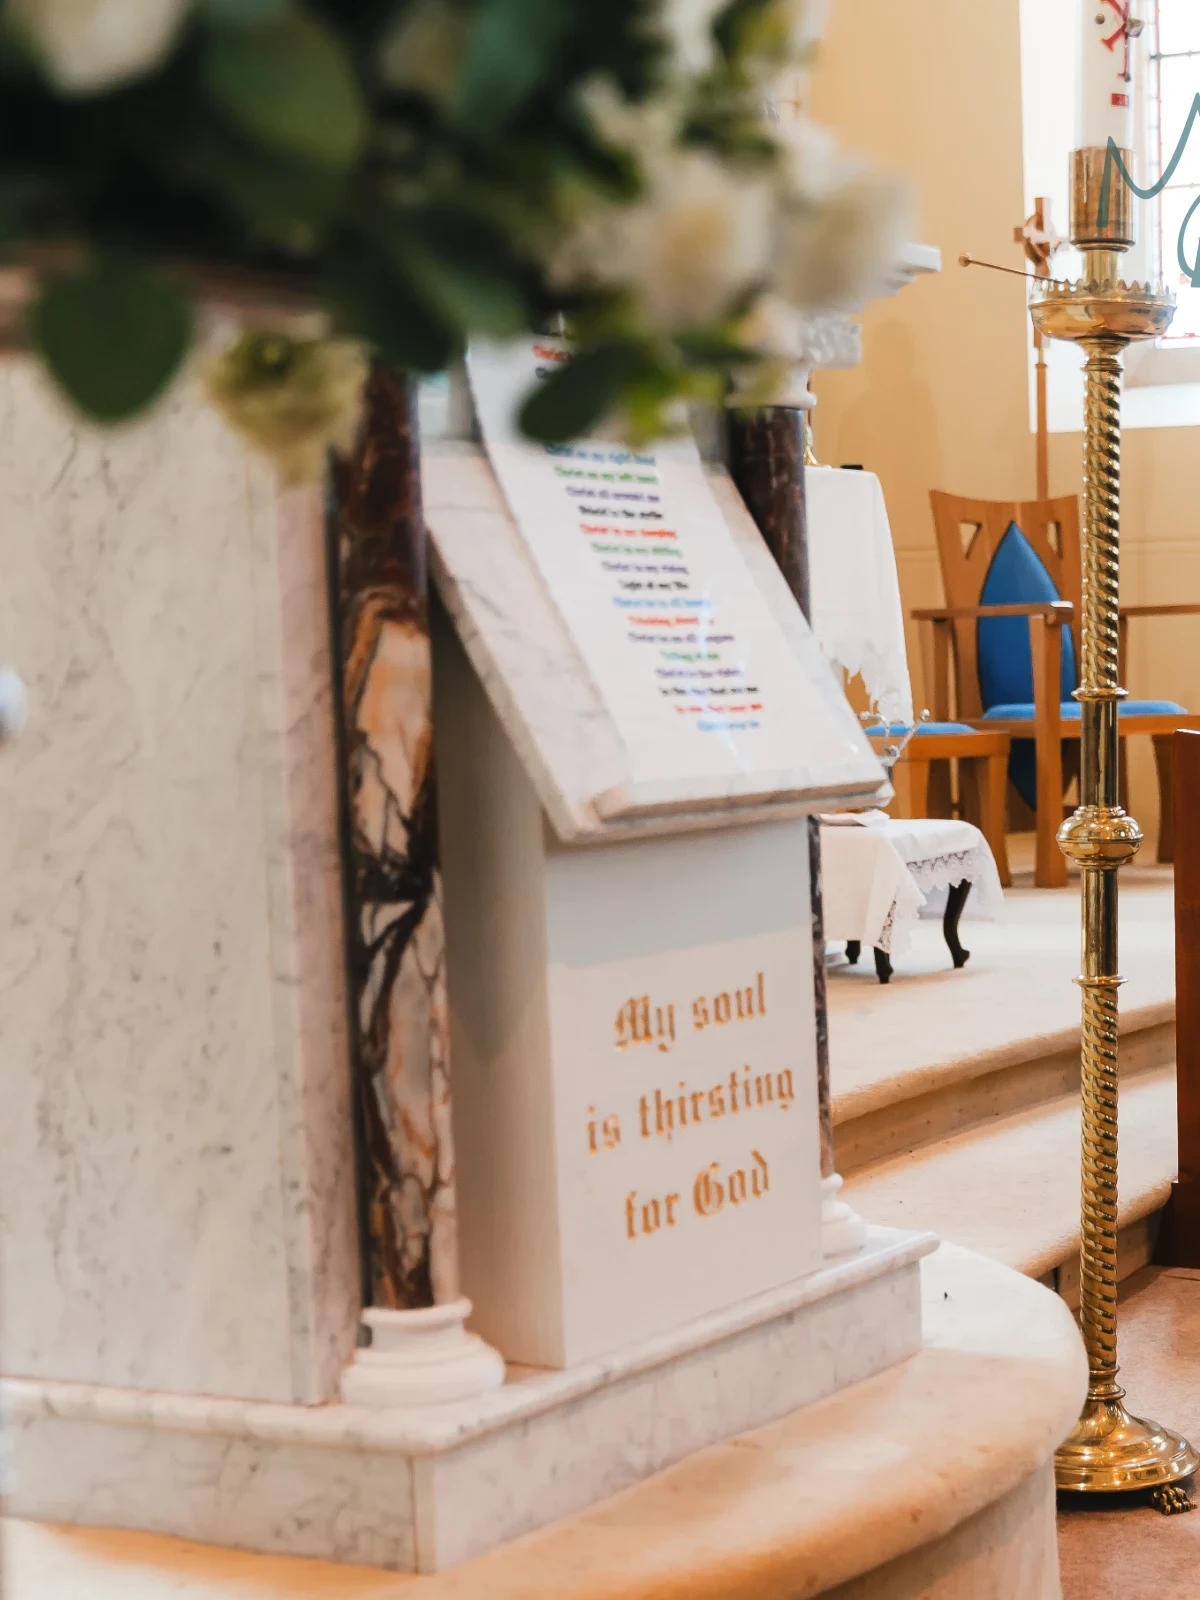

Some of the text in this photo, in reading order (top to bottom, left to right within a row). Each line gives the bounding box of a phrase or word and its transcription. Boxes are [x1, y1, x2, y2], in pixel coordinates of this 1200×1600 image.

[614, 971, 766, 1053] My soul
[587, 1064, 794, 1155] is thirsting
[625, 1150, 770, 1240] for God
